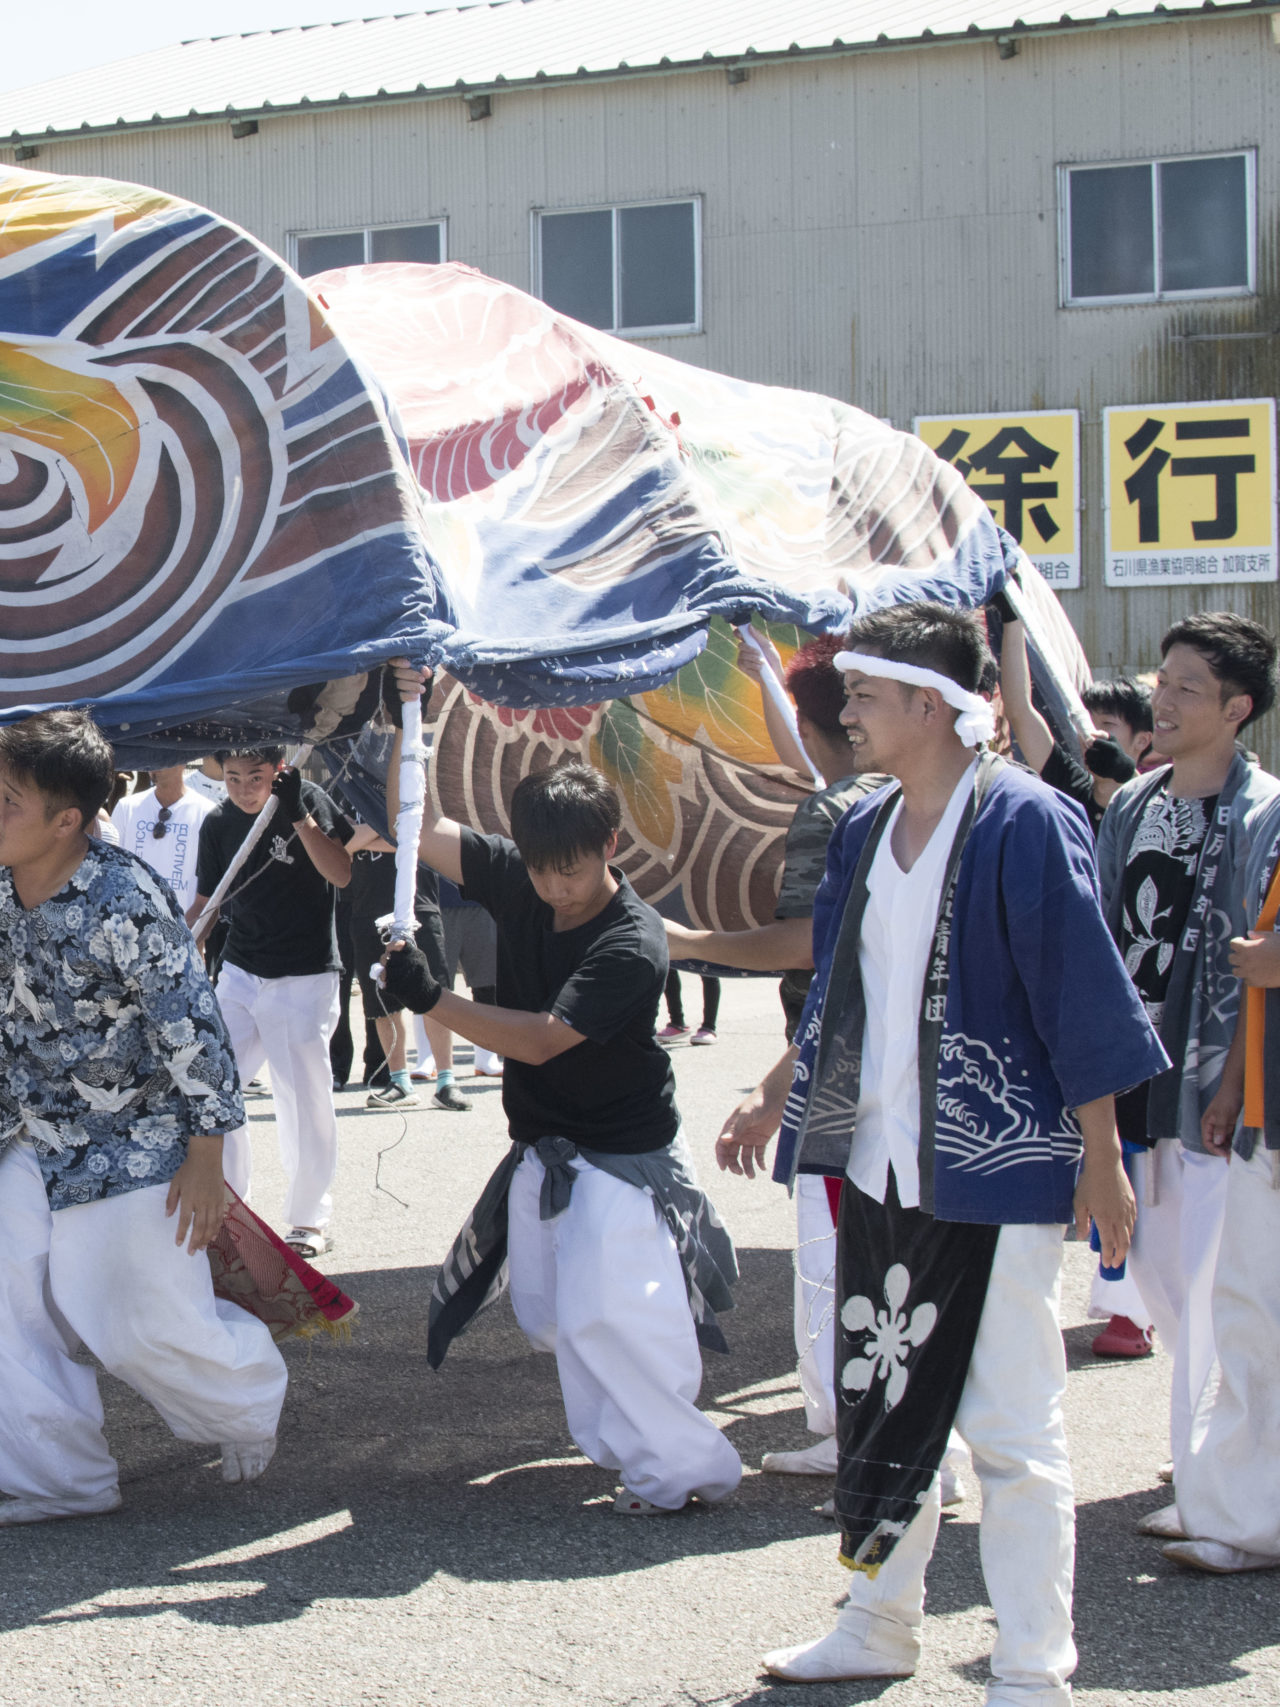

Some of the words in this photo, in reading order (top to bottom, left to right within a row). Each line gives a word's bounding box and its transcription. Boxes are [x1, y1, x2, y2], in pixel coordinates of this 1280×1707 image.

[933, 426, 1061, 545] 徐
[1123, 417, 1256, 544] 行
[1113, 555, 1218, 577] 石川県漁業協同組合
[1222, 553, 1271, 574] 加賀支所
